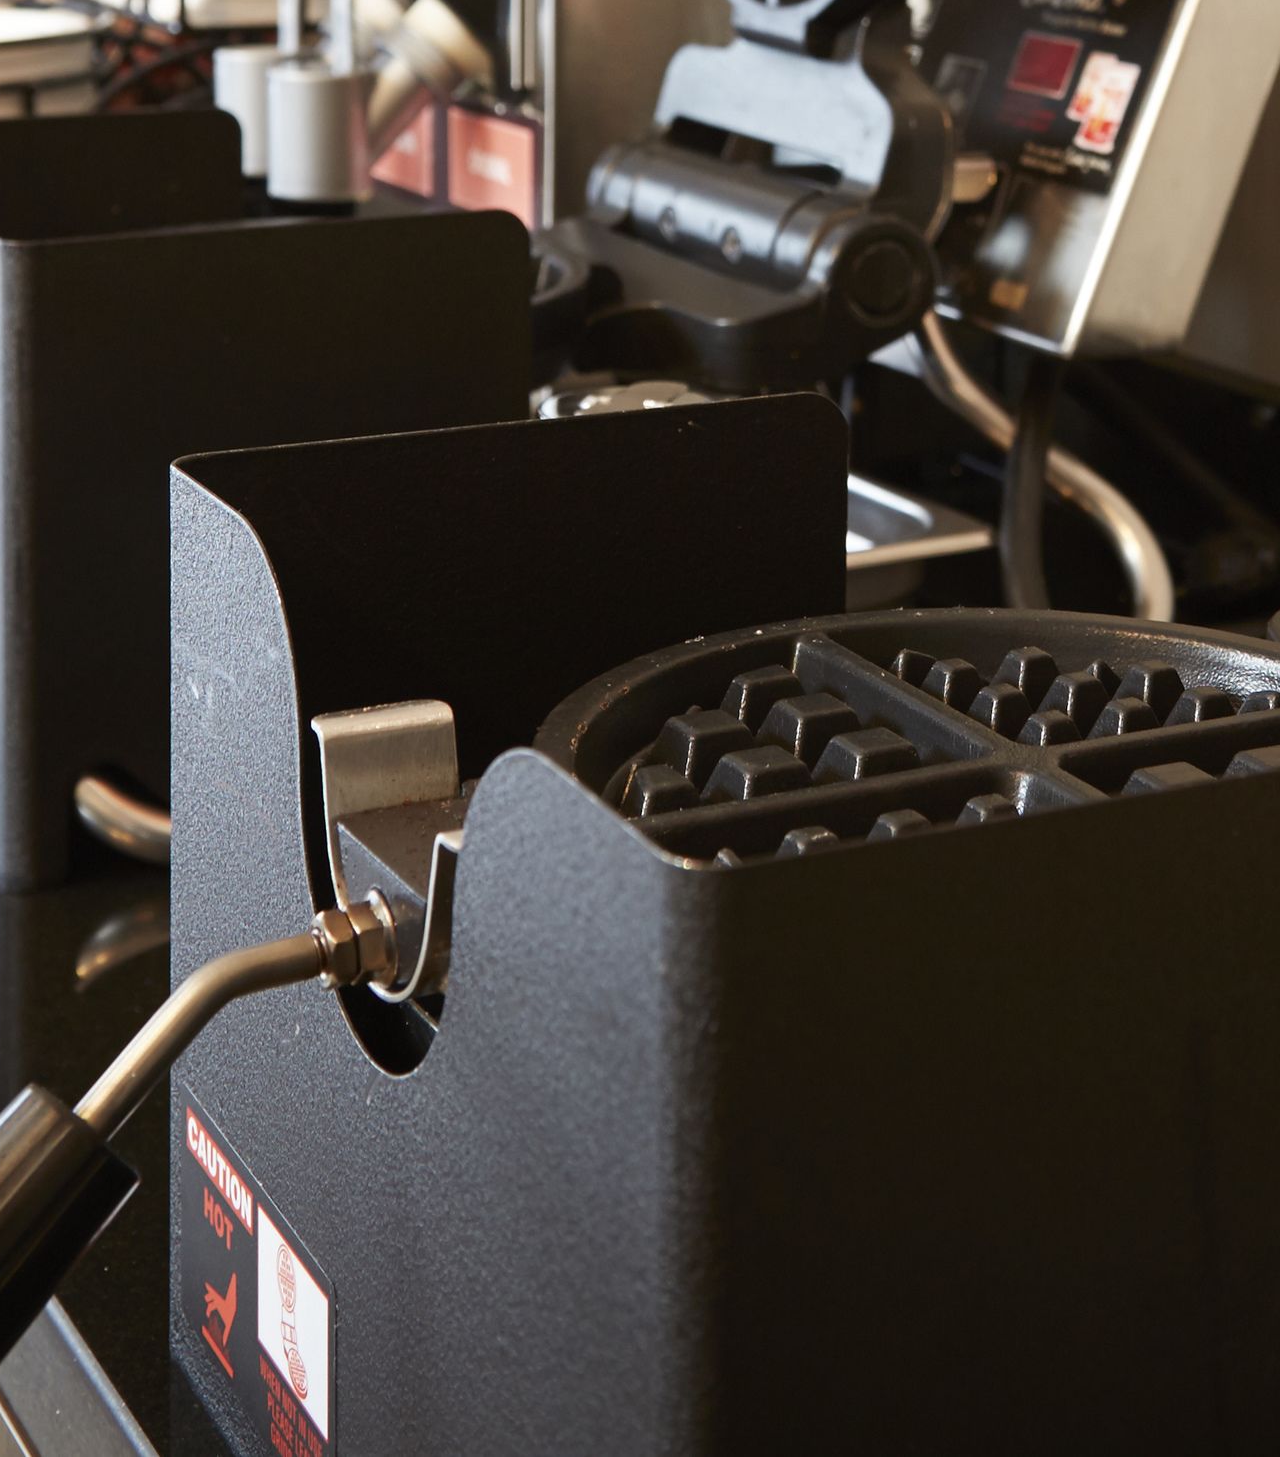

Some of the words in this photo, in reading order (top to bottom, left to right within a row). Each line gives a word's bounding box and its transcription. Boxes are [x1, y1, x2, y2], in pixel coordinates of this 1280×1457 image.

[187, 1116, 252, 1229] CAUTION
[204, 1186, 233, 1250] HOT
[259, 1353, 281, 1402] WHEN
